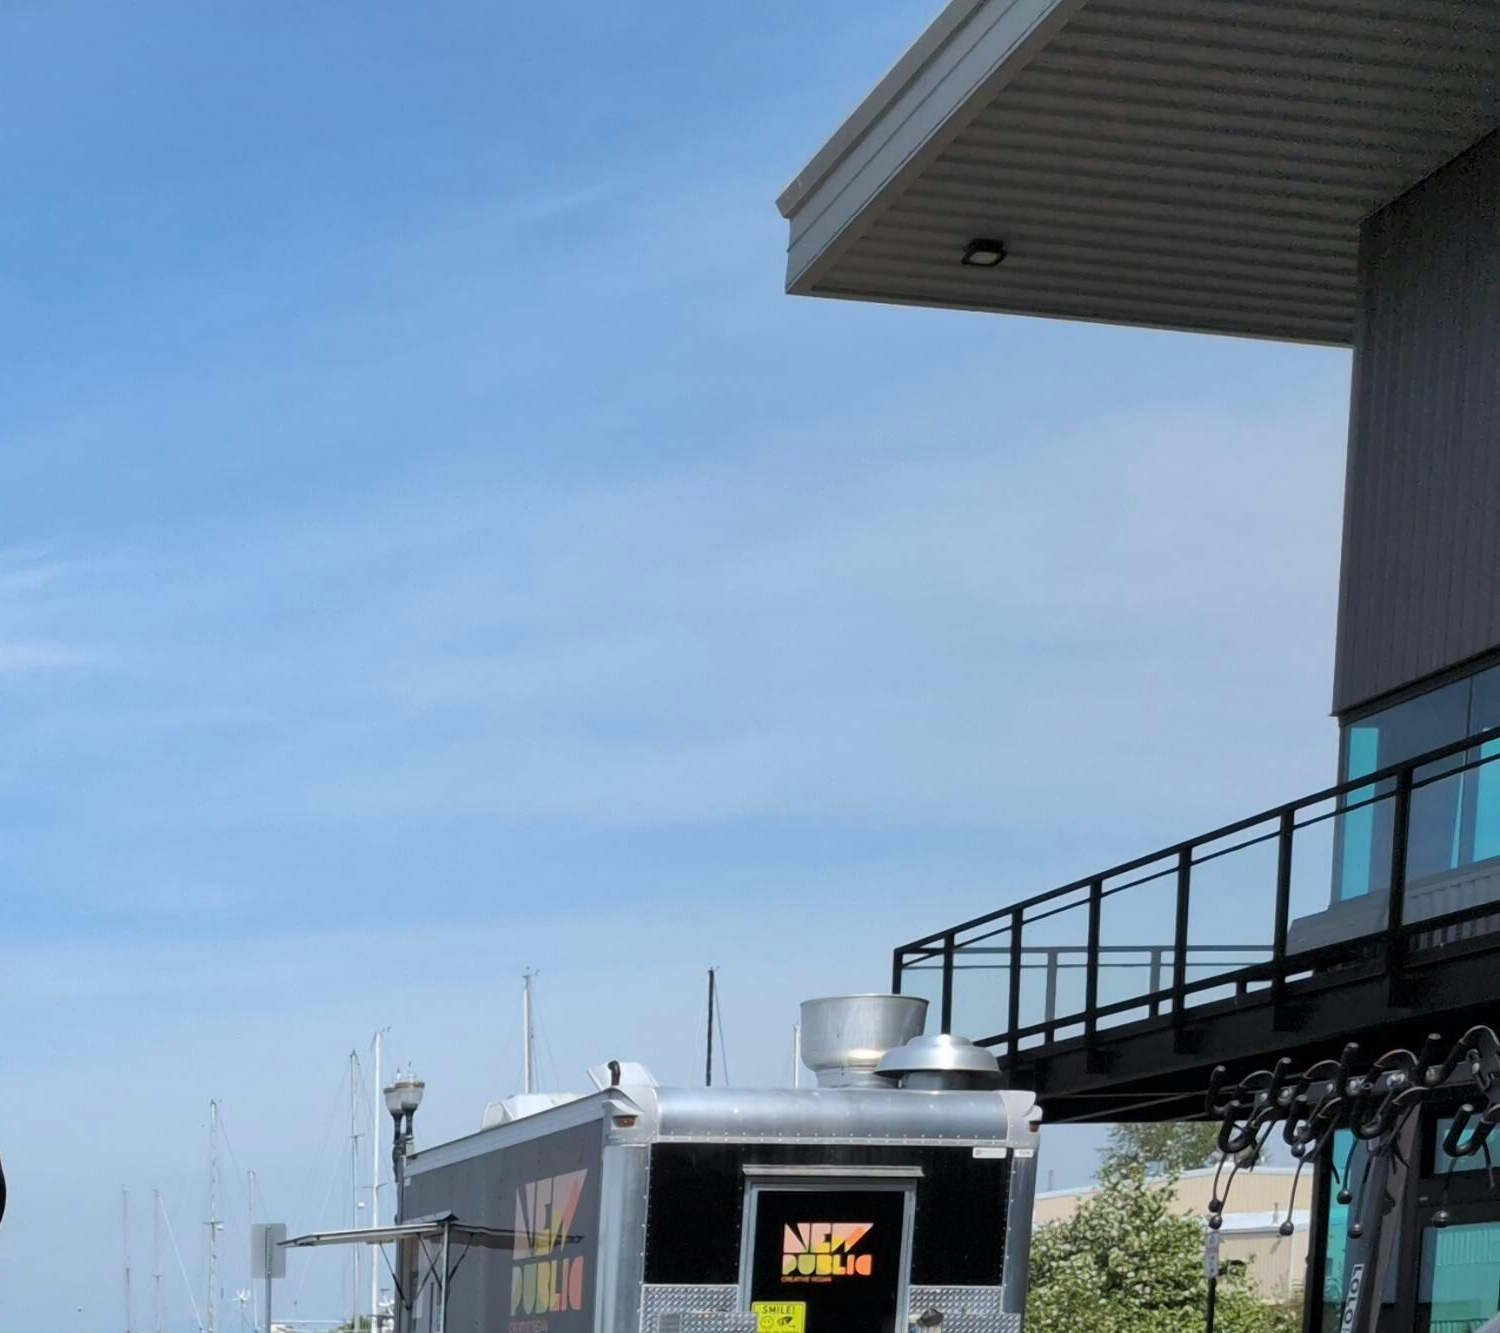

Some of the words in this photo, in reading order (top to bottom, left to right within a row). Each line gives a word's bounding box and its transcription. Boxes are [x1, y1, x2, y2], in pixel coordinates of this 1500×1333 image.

[512, 1168, 589, 1260] NEW
[782, 1222, 875, 1253] NEW
[510, 1255, 585, 1316] PUBLIC
[782, 1253, 872, 1276] PUBLIC
